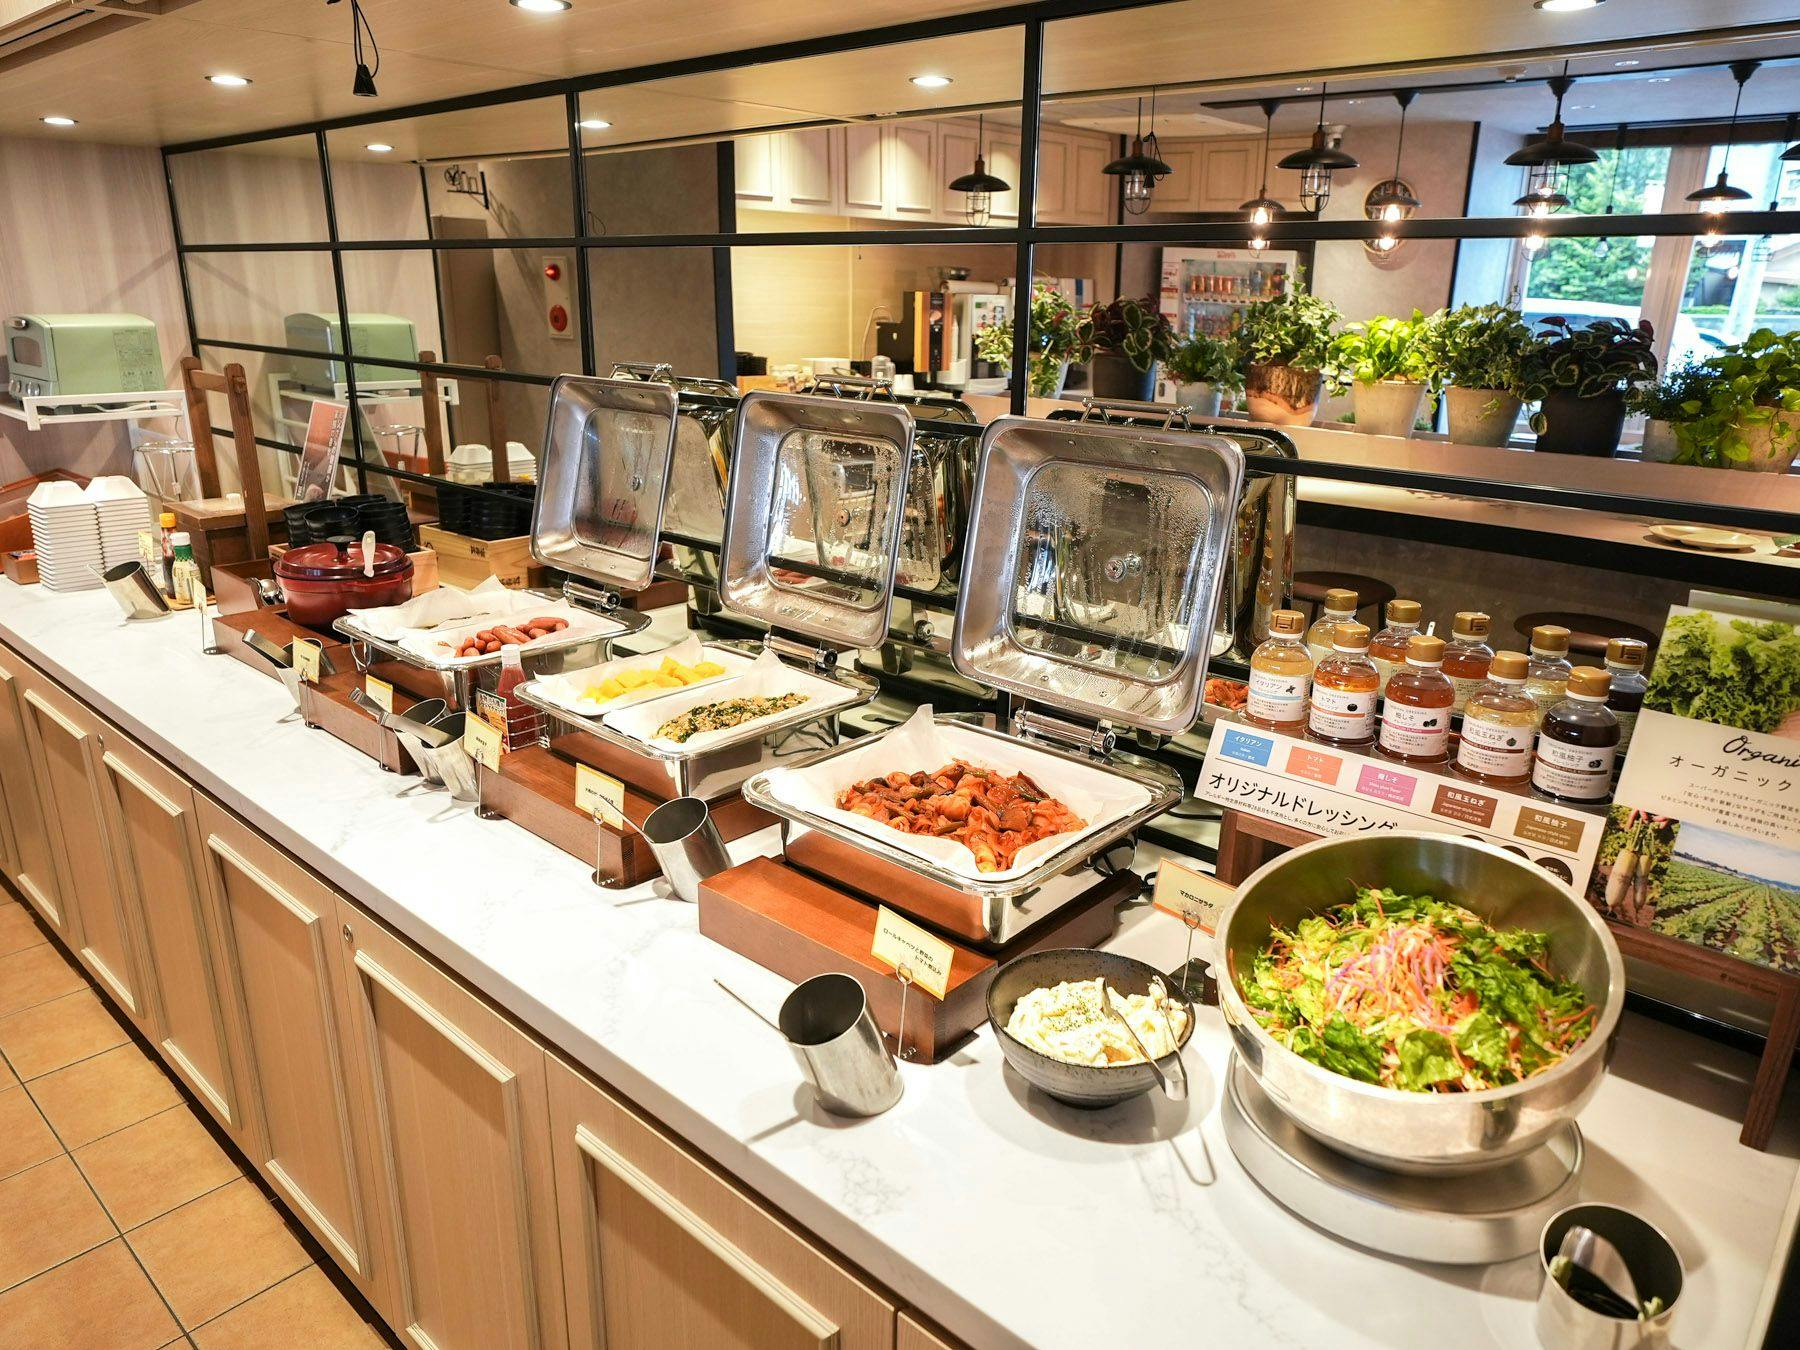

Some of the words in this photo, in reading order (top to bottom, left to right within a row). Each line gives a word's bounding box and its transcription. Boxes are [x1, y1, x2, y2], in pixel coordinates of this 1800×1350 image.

[1255, 680, 1283, 690] イタリアン
[1321, 695, 1336, 704] トマト
[1234, 735, 1263, 747] イタリアン
[1306, 753, 1324, 763] トマト
[1552, 749, 1584, 763] 和風柚子
[1669, 755, 1792, 792] オーガニック
[1209, 772, 1399, 833] オリジナルドレッシング
[1447, 791, 1487, 807] 和風玉ねぎ
[1534, 813, 1568, 829] 和風柚子
[1180, 889, 1214, 909] マカロニサラダ
